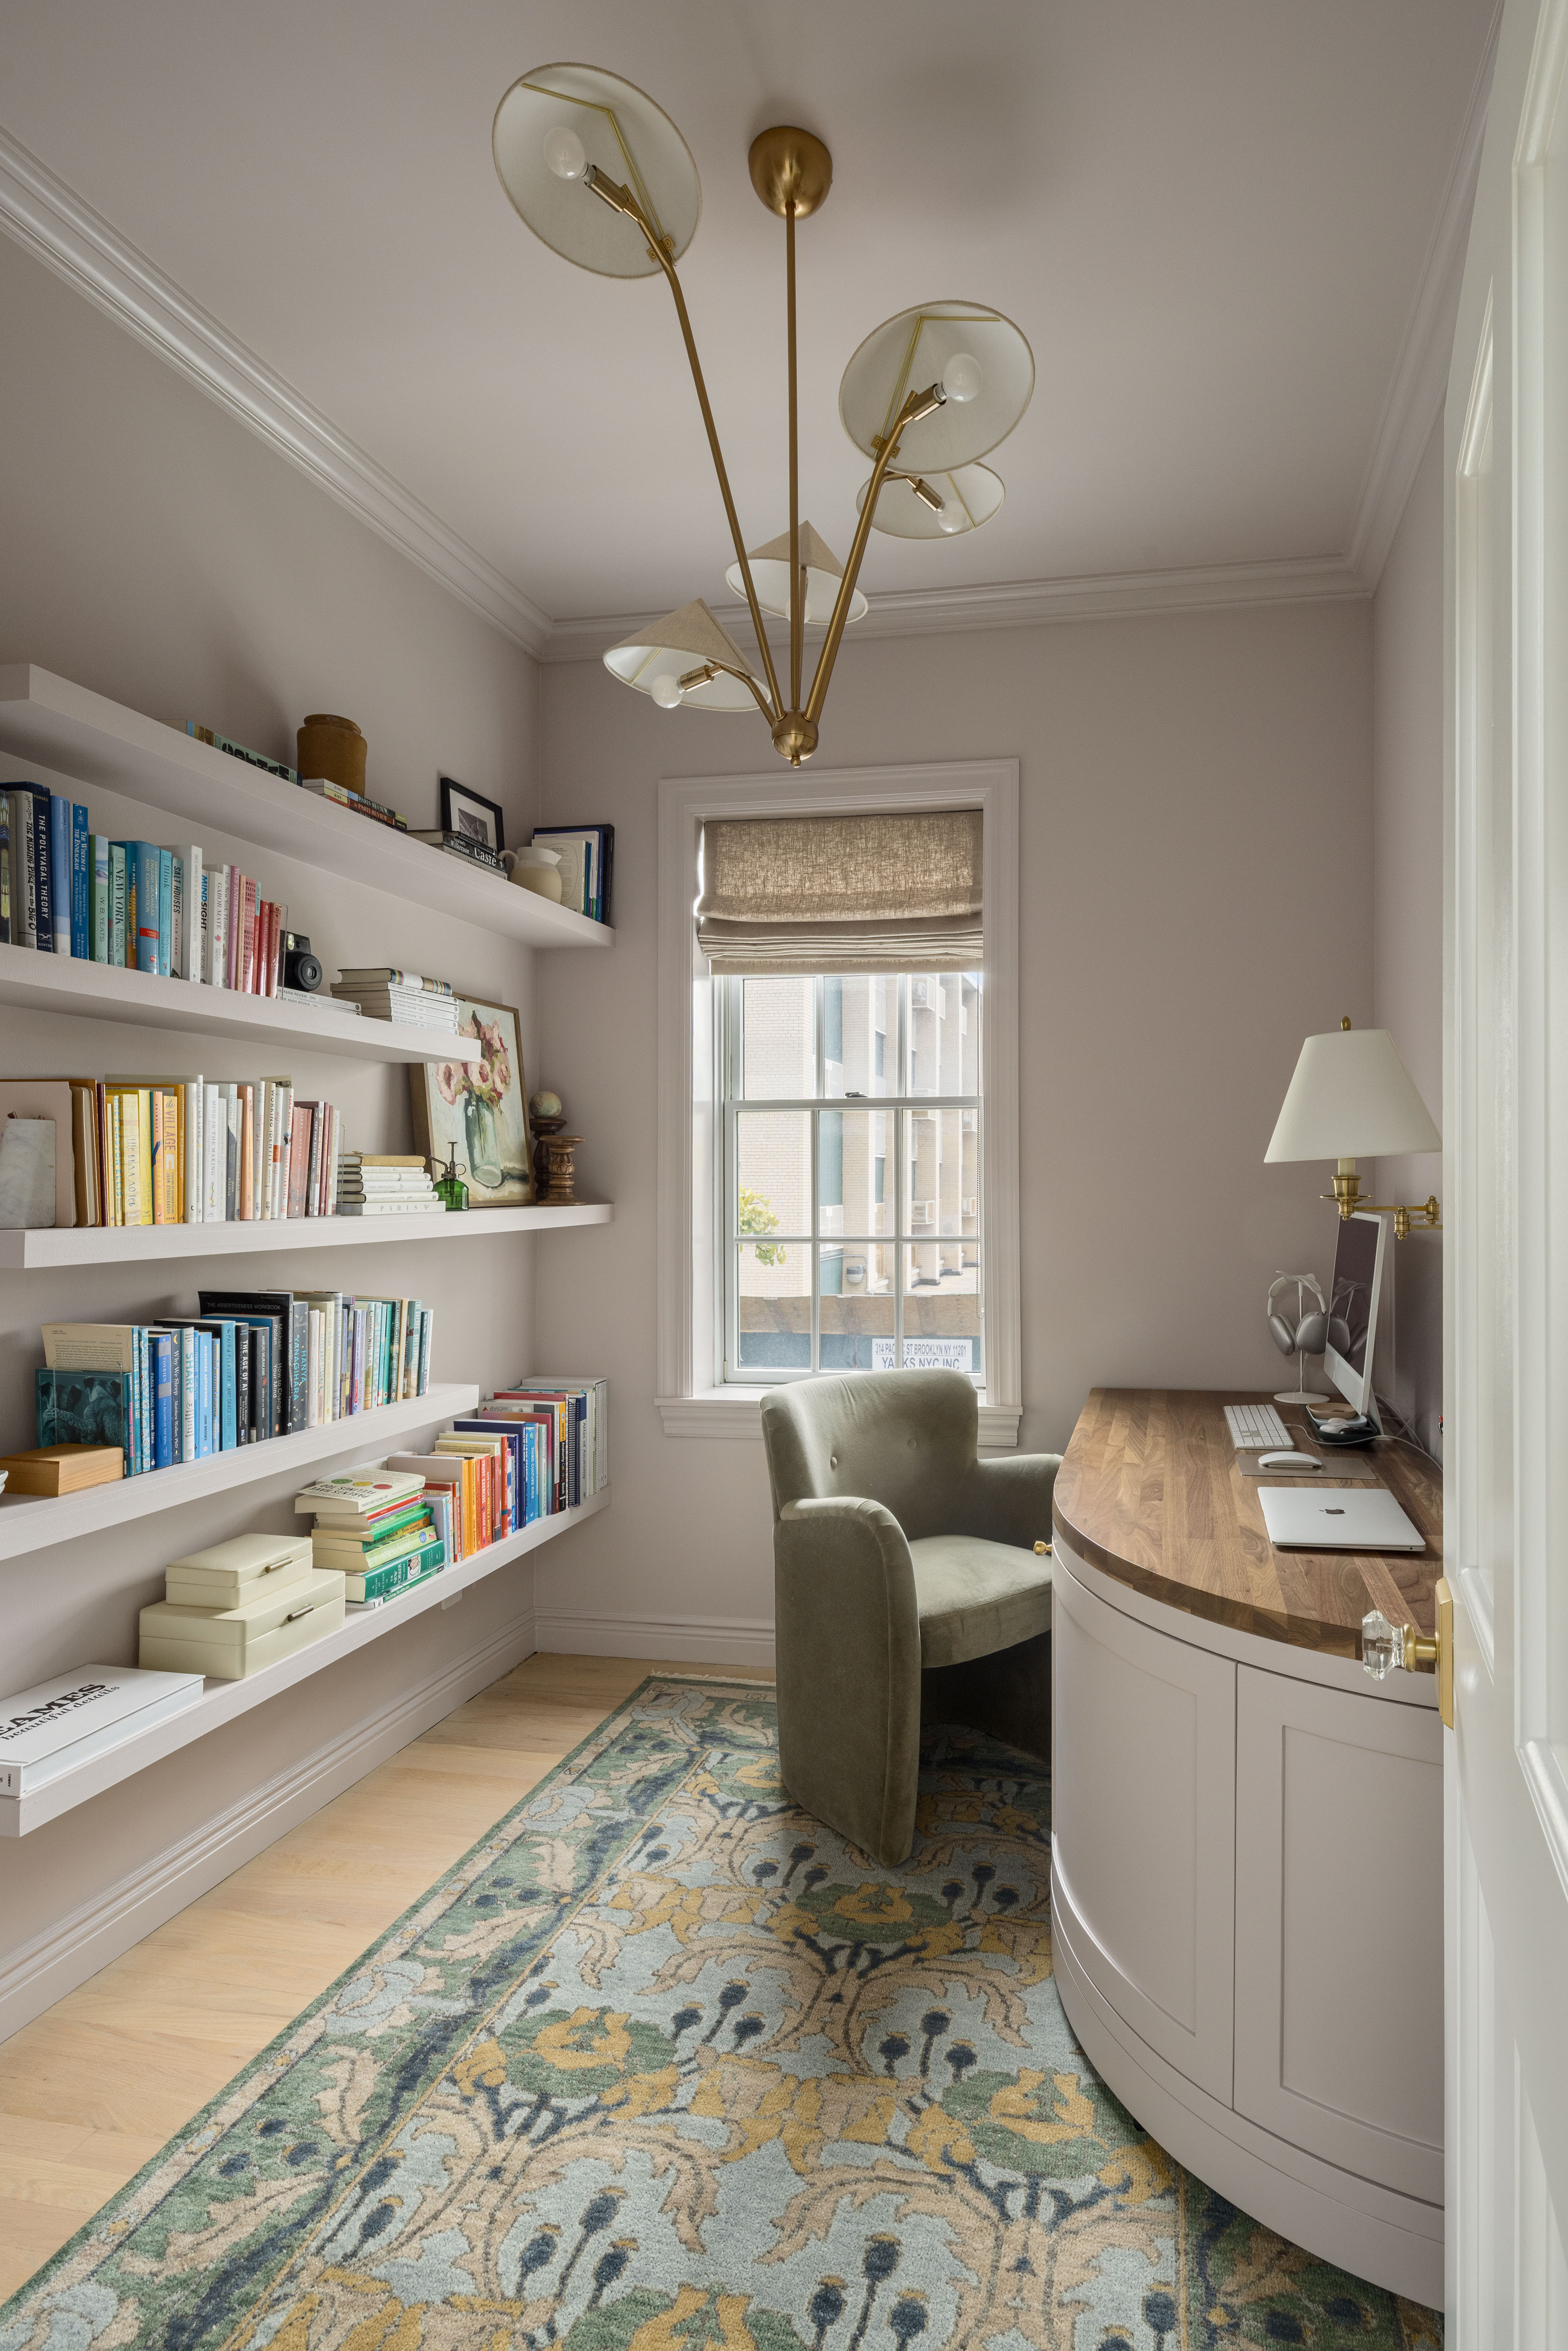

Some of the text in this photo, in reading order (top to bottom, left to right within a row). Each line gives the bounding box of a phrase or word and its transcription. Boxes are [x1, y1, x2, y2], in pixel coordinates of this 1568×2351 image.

[358, 796, 389, 813] PARIS REVIEW
[27, 836, 35, 864] MISSING
[451, 840, 470, 854] Wilkerson
[39, 834, 47, 881] POLYVAGAL
[474, 847, 496, 866] Caste
[116, 867, 124, 894] NEW
[100, 897, 105, 905] W.
[115, 896, 124, 924] YORK
[28, 923, 36, 931] O
[164, 1099, 176, 1151] the VILLAGE
[875, 1343, 884, 1354] 314
[906, 1345, 913, 1354] ST
[914, 1344, 943, 1355] BROOKLYN
[944, 1345, 951, 1355] NY
[953, 1345, 966, 1355] 11201
[882, 1356, 959, 1370] YAKS NYC INC
[174, 1367, 179, 1378] We
[185, 1352, 193, 1393] SHARP
[242, 1372, 248, 1381] OF
[331, 1490, 371, 1498] PARENTS
[386, 1532, 398, 1540] Hutch
[385, 1585, 410, 1601] Hacking Healthcare
[0, 1685, 120, 1740] beautiful details
